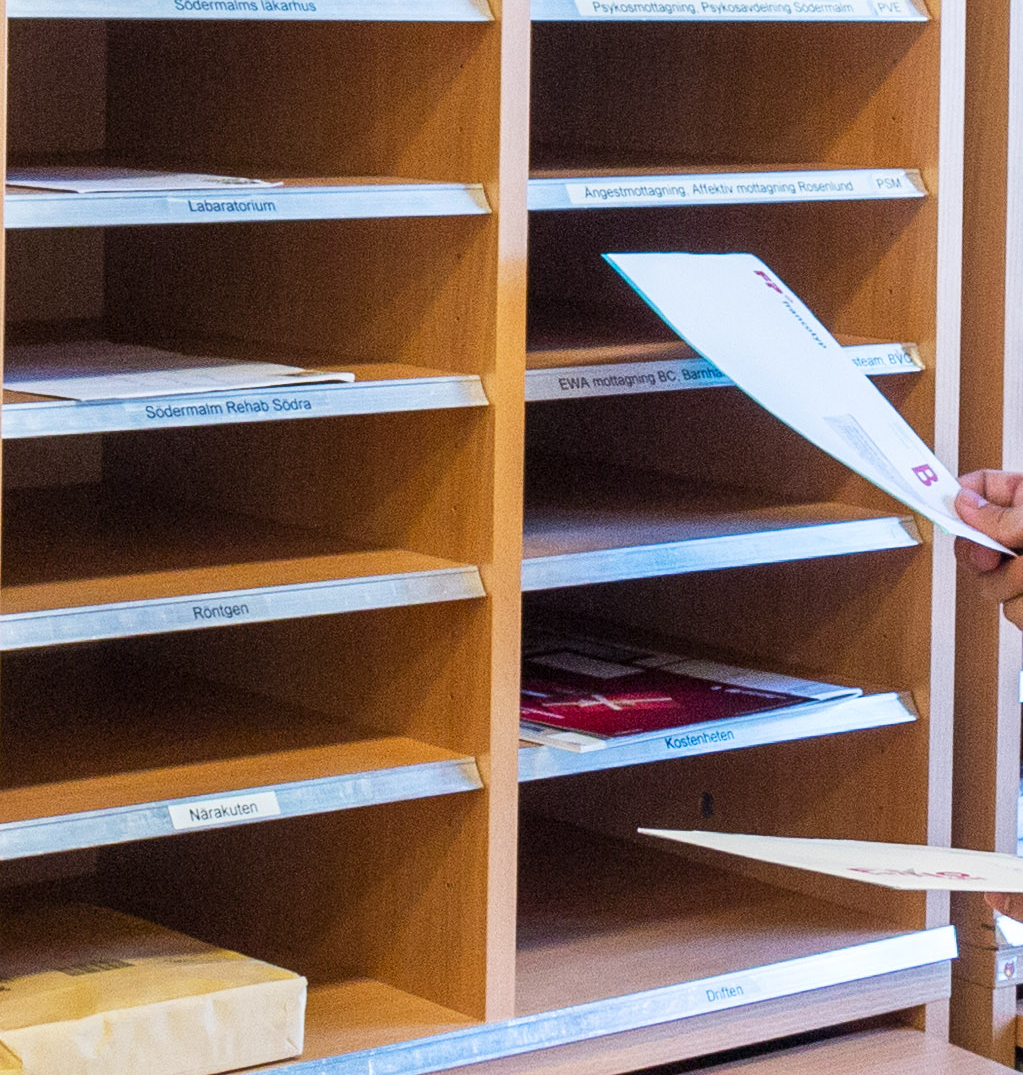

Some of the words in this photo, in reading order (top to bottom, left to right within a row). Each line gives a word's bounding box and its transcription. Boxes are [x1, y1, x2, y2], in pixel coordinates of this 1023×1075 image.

[700, 0, 792, 15] Psykosavdelning
[877, 1, 902, 14] PVE
[692, 182, 734, 195] Affektiv
[736, 180, 797, 195] mottagning
[797, 180, 854, 193] Rosenlund
[875, 177, 903, 190] PSM
[187, 199, 277, 213] Labaratorium
[559, 376, 591, 391] EWA
[592, 372, 656, 388] mottagning
[145, 401, 224, 420] Södermalm
[225, 398, 270, 415] Rehab
[272, 397, 313, 413] Södra
[911, 463, 939, 487] B
[192, 602, 250, 621] Röntgen
[664, 728, 735, 751] Kostenheten
[188, 800, 259, 823] Närakuten
[705, 984, 745, 1003] Driften
